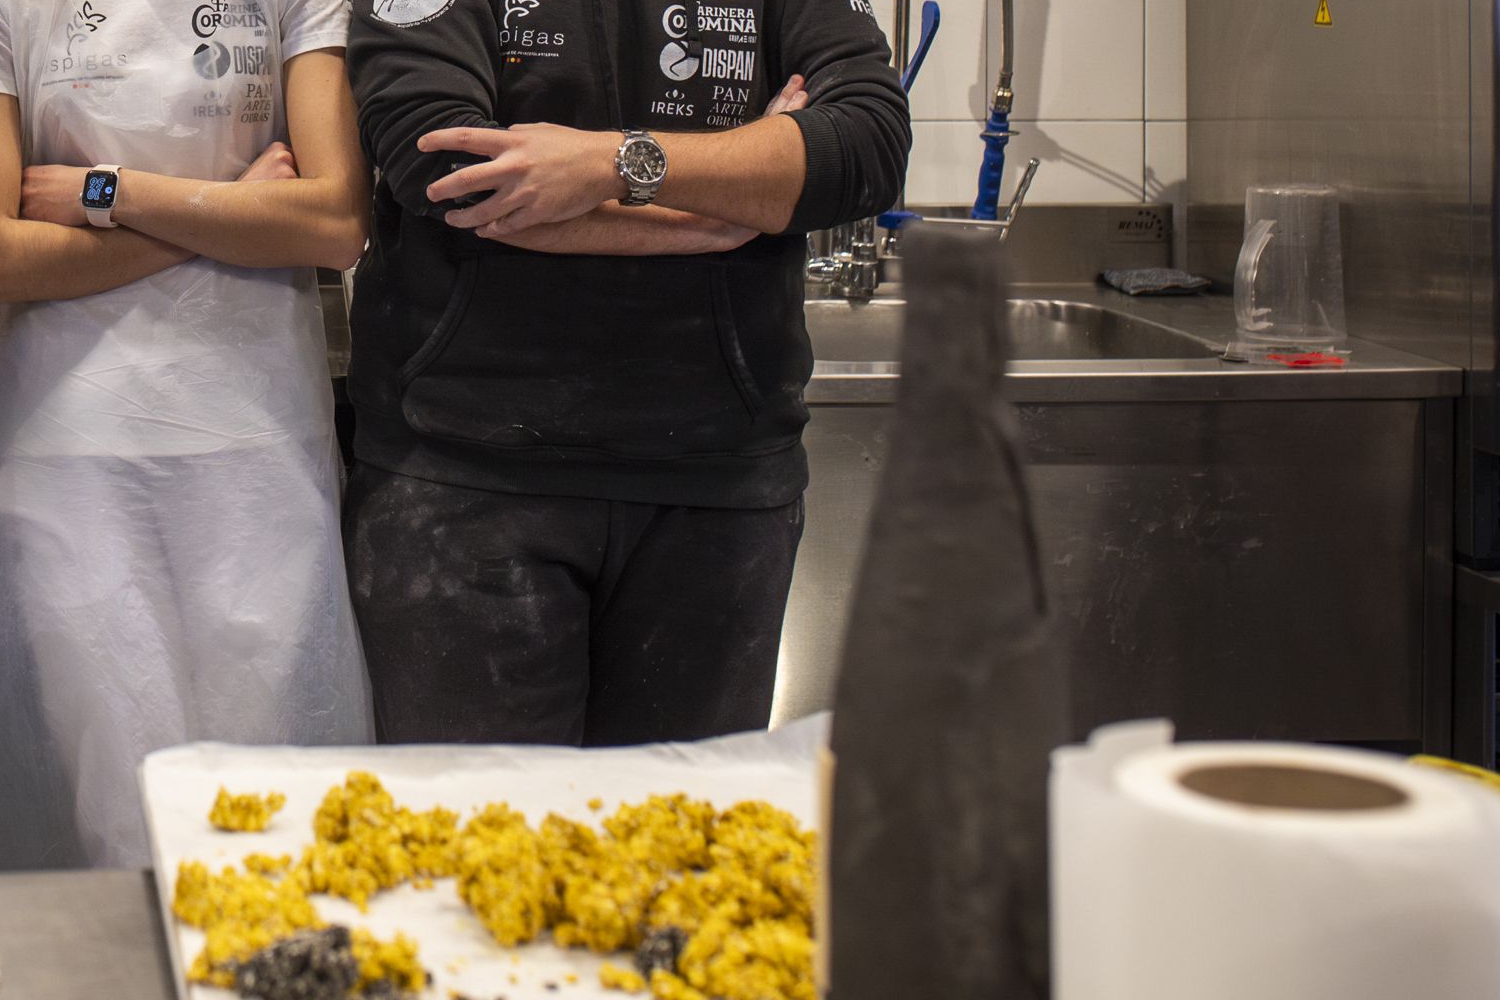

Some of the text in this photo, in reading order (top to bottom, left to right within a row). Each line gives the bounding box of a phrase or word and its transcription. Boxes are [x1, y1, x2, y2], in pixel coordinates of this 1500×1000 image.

[696, 0, 755, 18] ARINERA
[701, 47, 756, 82] DISPAN
[711, 85, 751, 104] PAN
[192, 105, 232, 118] IREKS
[650, 100, 695, 117] IREKS
